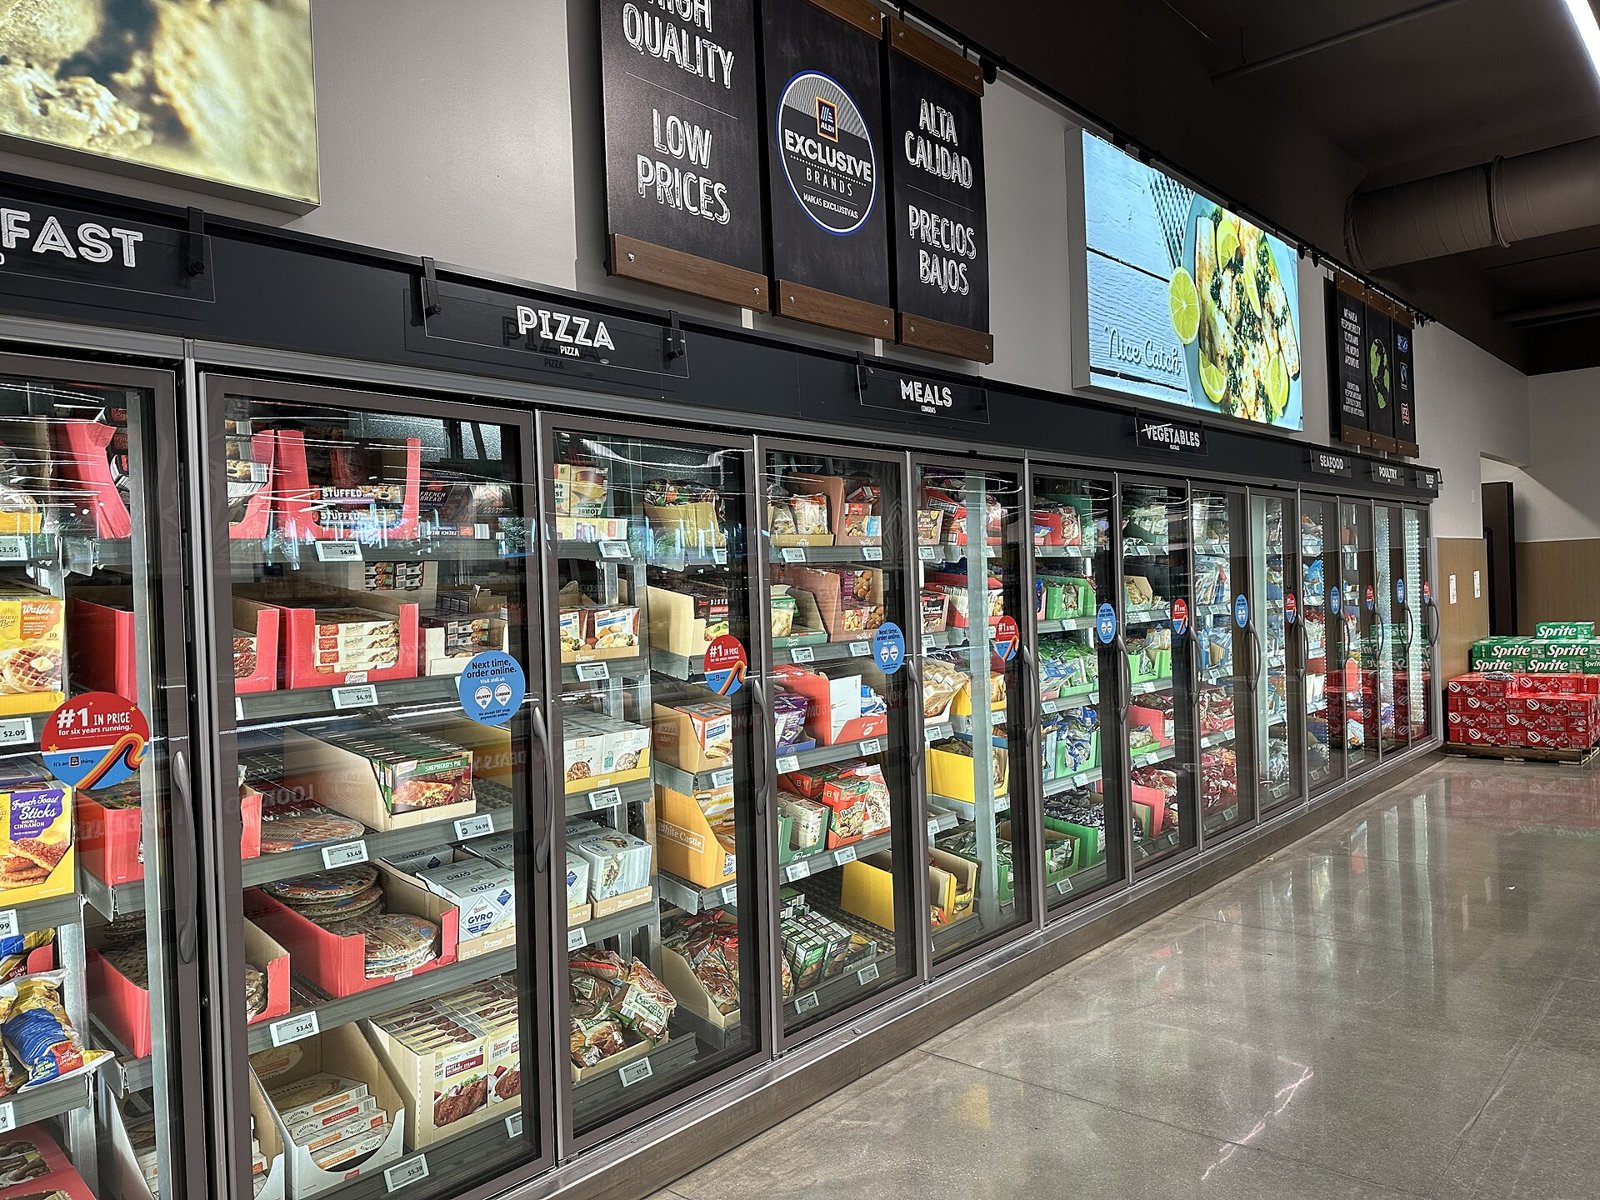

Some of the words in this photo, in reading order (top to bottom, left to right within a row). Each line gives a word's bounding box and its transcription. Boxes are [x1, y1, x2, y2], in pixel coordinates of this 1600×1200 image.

[622, 3, 734, 89] QUALITY
[821, 123, 834, 134] ALDI
[919, 98, 958, 146] ALTA
[651, 108, 712, 169] LOW
[784, 128, 872, 182] EXCLUSIVE
[904, 130, 974, 189] CALIDAD
[636, 154, 731, 225] PRICES
[806, 168, 853, 197] BRANDS
[803, 192, 822, 206] MARCAS
[822, 200, 859, 219] EXCLUSIVAS
[0, 207, 144, 268] FAST
[908, 204, 977, 260] PRECIOS
[919, 248, 970, 296] BAJOS
[516, 305, 616, 350] PIZZA
[559, 345, 580, 357] PIZZA
[1104, 325, 1142, 365] Nice
[1145, 340, 1182, 376] Catch
[900, 378, 953, 408] MEALS
[1144, 423, 1201, 448] VEGETABLES
[1319, 454, 1344, 470] SEAFOOD
[1378, 466, 1398, 480] POULTRY
[322, 487, 363, 499] STUFFED
[320, 510, 360, 521] STUFFED
[1537, 625, 1577, 639] Sprite
[709, 644, 723, 658] #1
[1491, 644, 1531, 658] Sprite
[1547, 644, 1589, 658] Sprite
[467, 669, 489, 679] order
[490, 666, 517, 676] online.
[472, 660, 490, 670] Next
[491, 659, 511, 668] time,
[1473, 658, 1512, 672] Sprite
[1527, 657, 1569, 672] Sprite
[57, 707, 88, 729] #1
[93, 714, 104, 726] IN
[107, 712, 131, 724] PRICE
[3, 729, 26, 738] $2.09
[58, 728, 69, 736] for
[82, 727, 100, 736] years
[19, 803, 57, 820] Sticks
[657, 821, 679, 838] White
[680, 832, 703, 848] Castle
[470, 882, 495, 893] GYRO
[468, 911, 494, 925] GYRO
[296, 1022, 312, 1033] $3.49
[407, 1165, 423, 1177] $5.39
